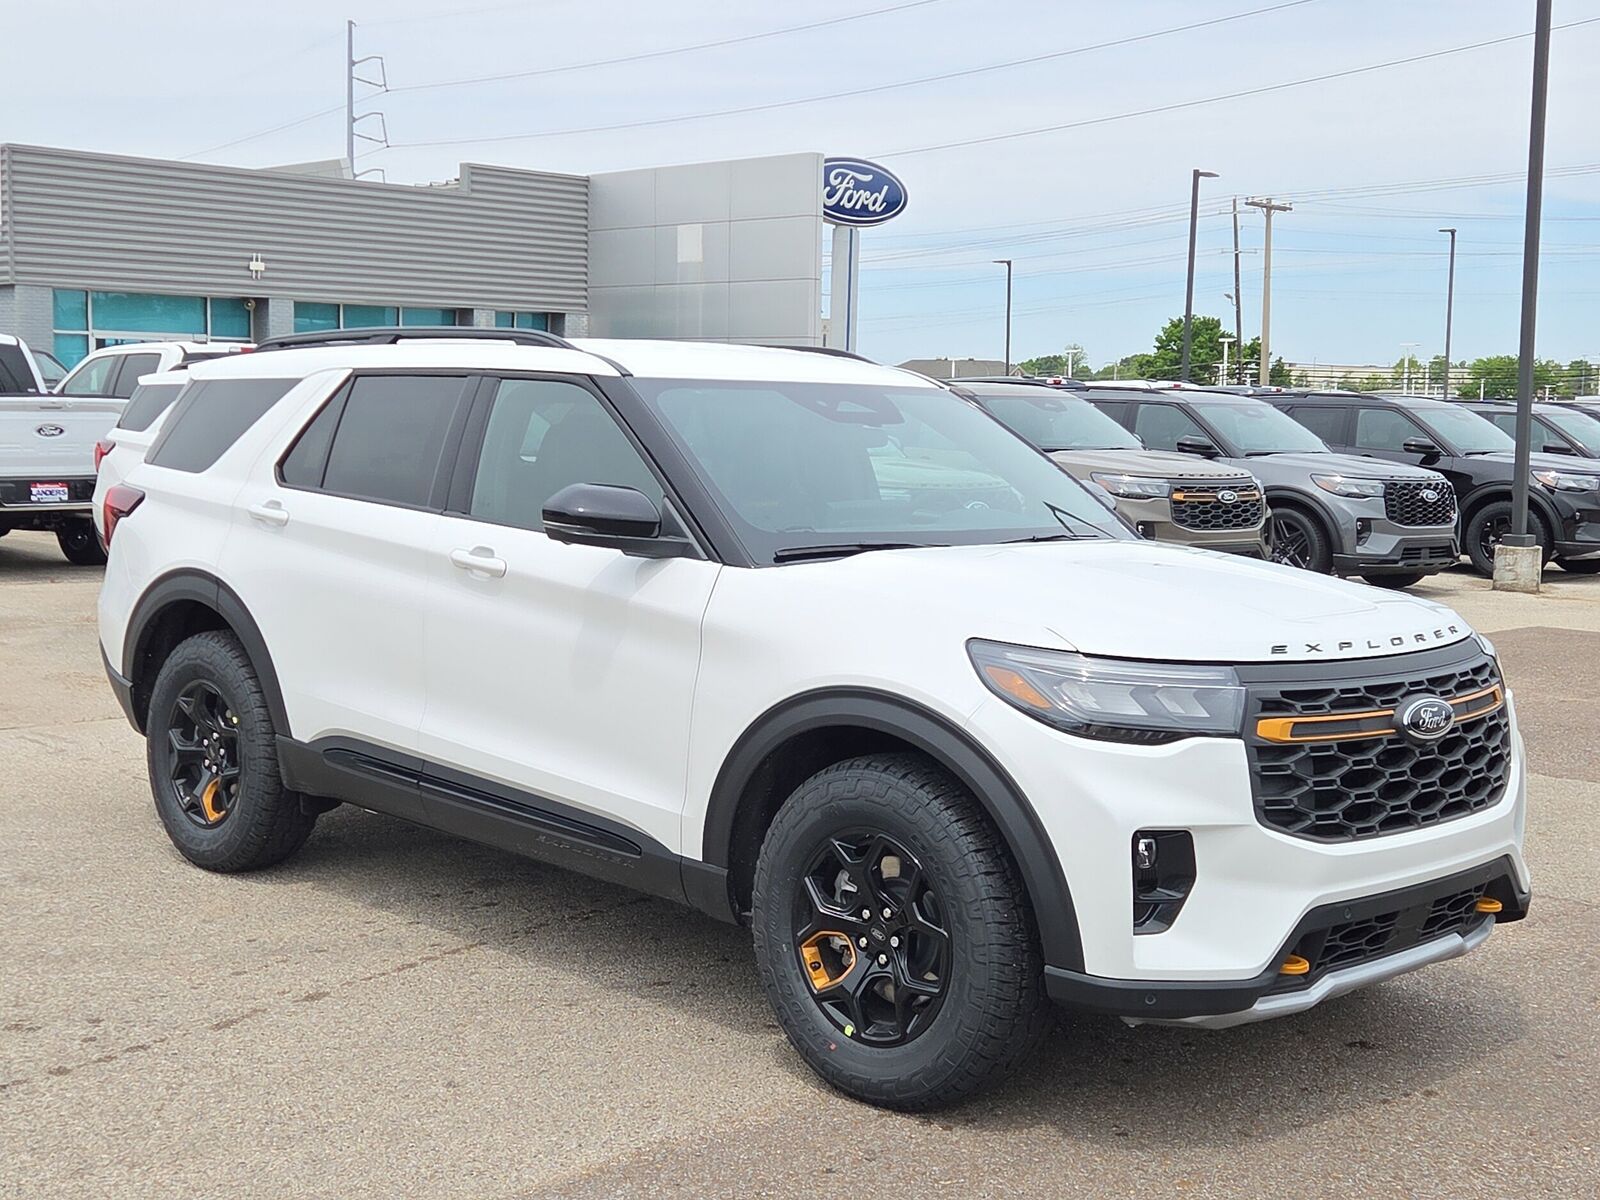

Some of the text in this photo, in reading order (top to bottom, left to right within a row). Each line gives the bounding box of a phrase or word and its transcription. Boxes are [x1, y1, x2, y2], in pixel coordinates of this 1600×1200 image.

[823, 168, 889, 212] Ford
[1270, 625, 1459, 654] EXPLORER
[1419, 706, 1447, 731] Ford
